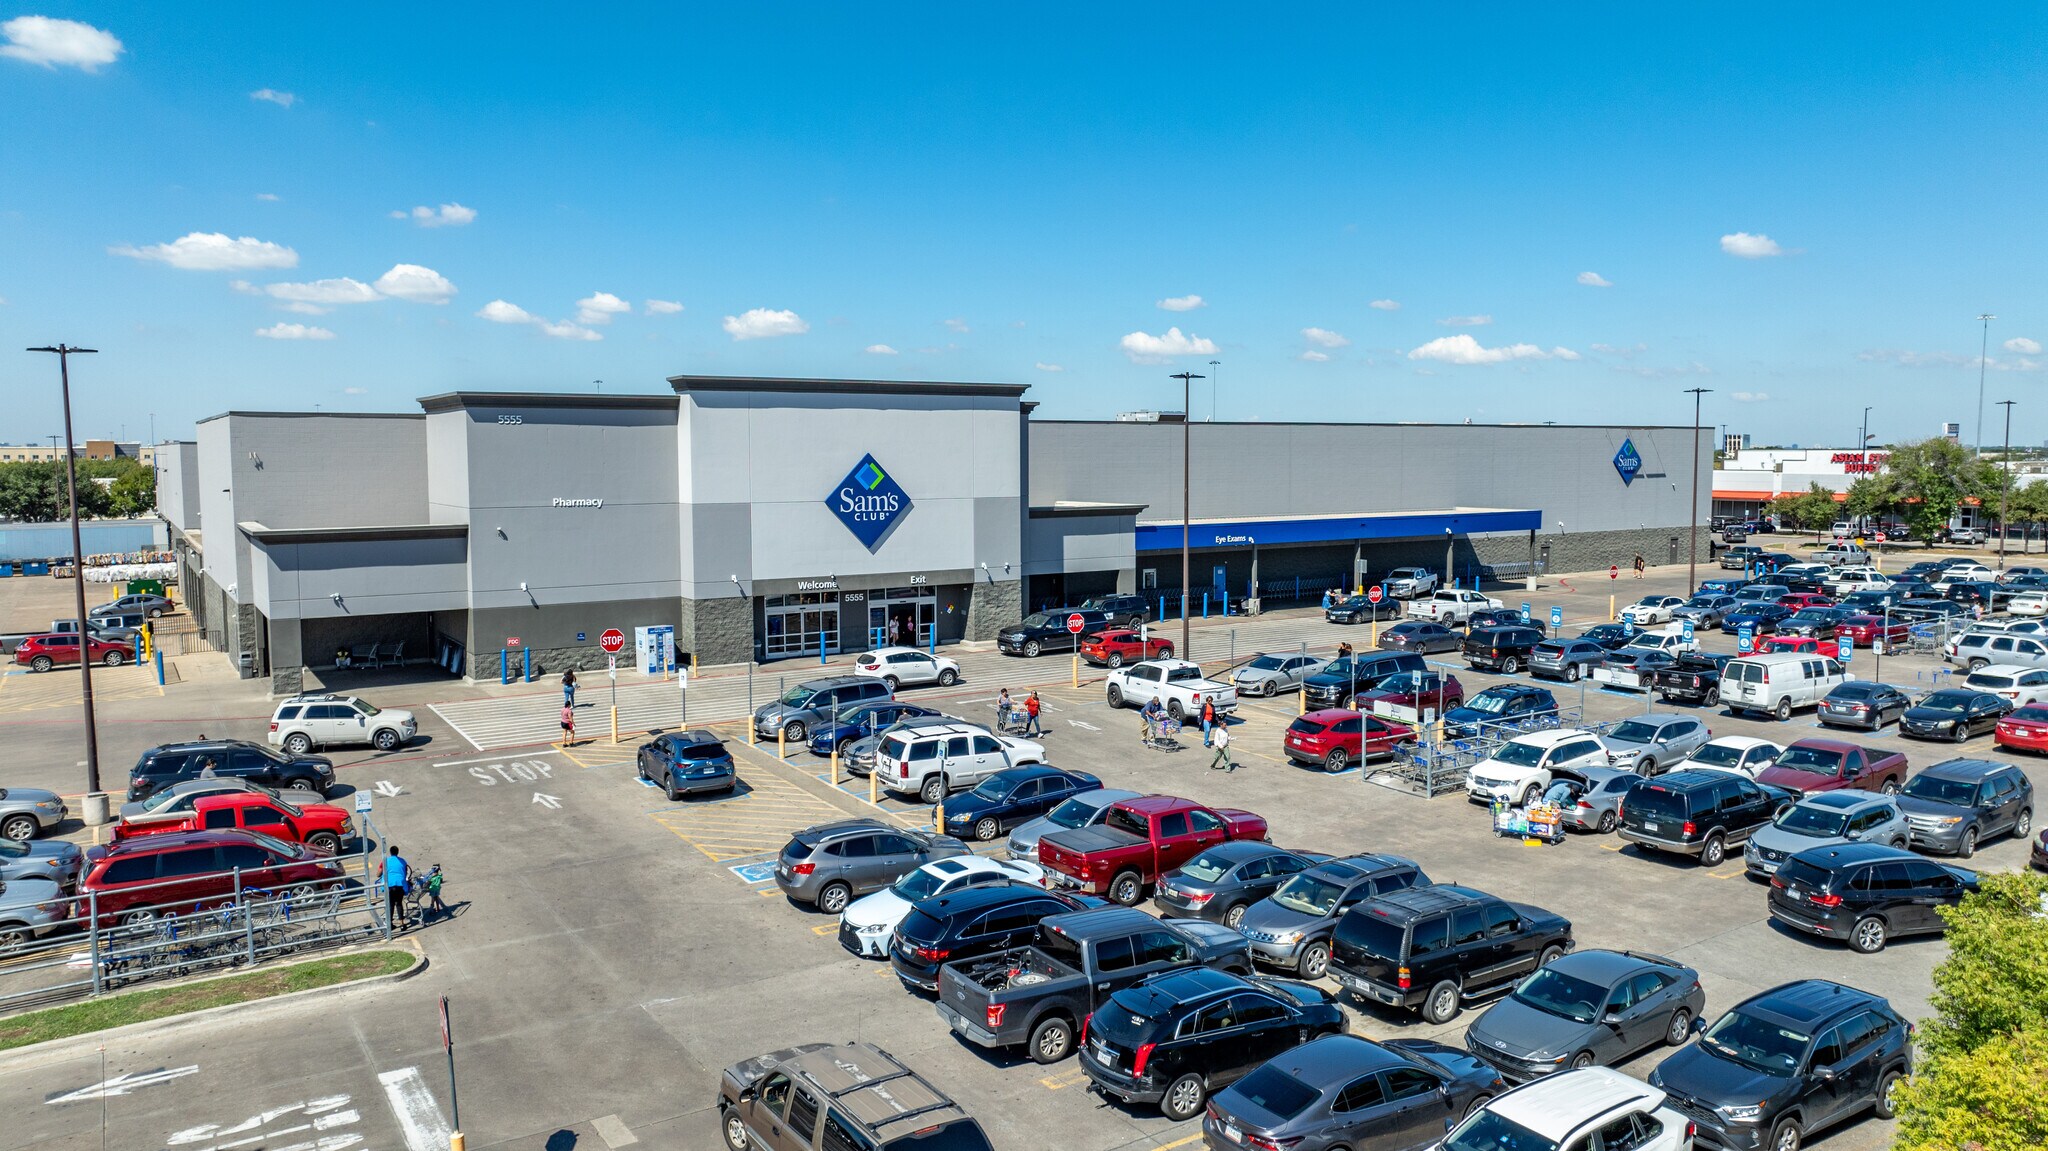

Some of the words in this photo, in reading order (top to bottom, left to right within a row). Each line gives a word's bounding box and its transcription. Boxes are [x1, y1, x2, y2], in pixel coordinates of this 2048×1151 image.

[498, 415, 522, 424] 5555
[1618, 455, 1638, 467] Sam's
[1831, 453, 1863, 462] ASIAN
[1845, 464, 1880, 473] BUFFET
[553, 498, 604, 509] Pharmacy
[840, 487, 899, 513] Sam's
[798, 580, 838, 591] Welcome
[910, 576, 926, 585] Exit
[845, 593, 865, 602] 5555
[602, 636, 623, 646] STOP
[468, 760, 552, 786] STOP
